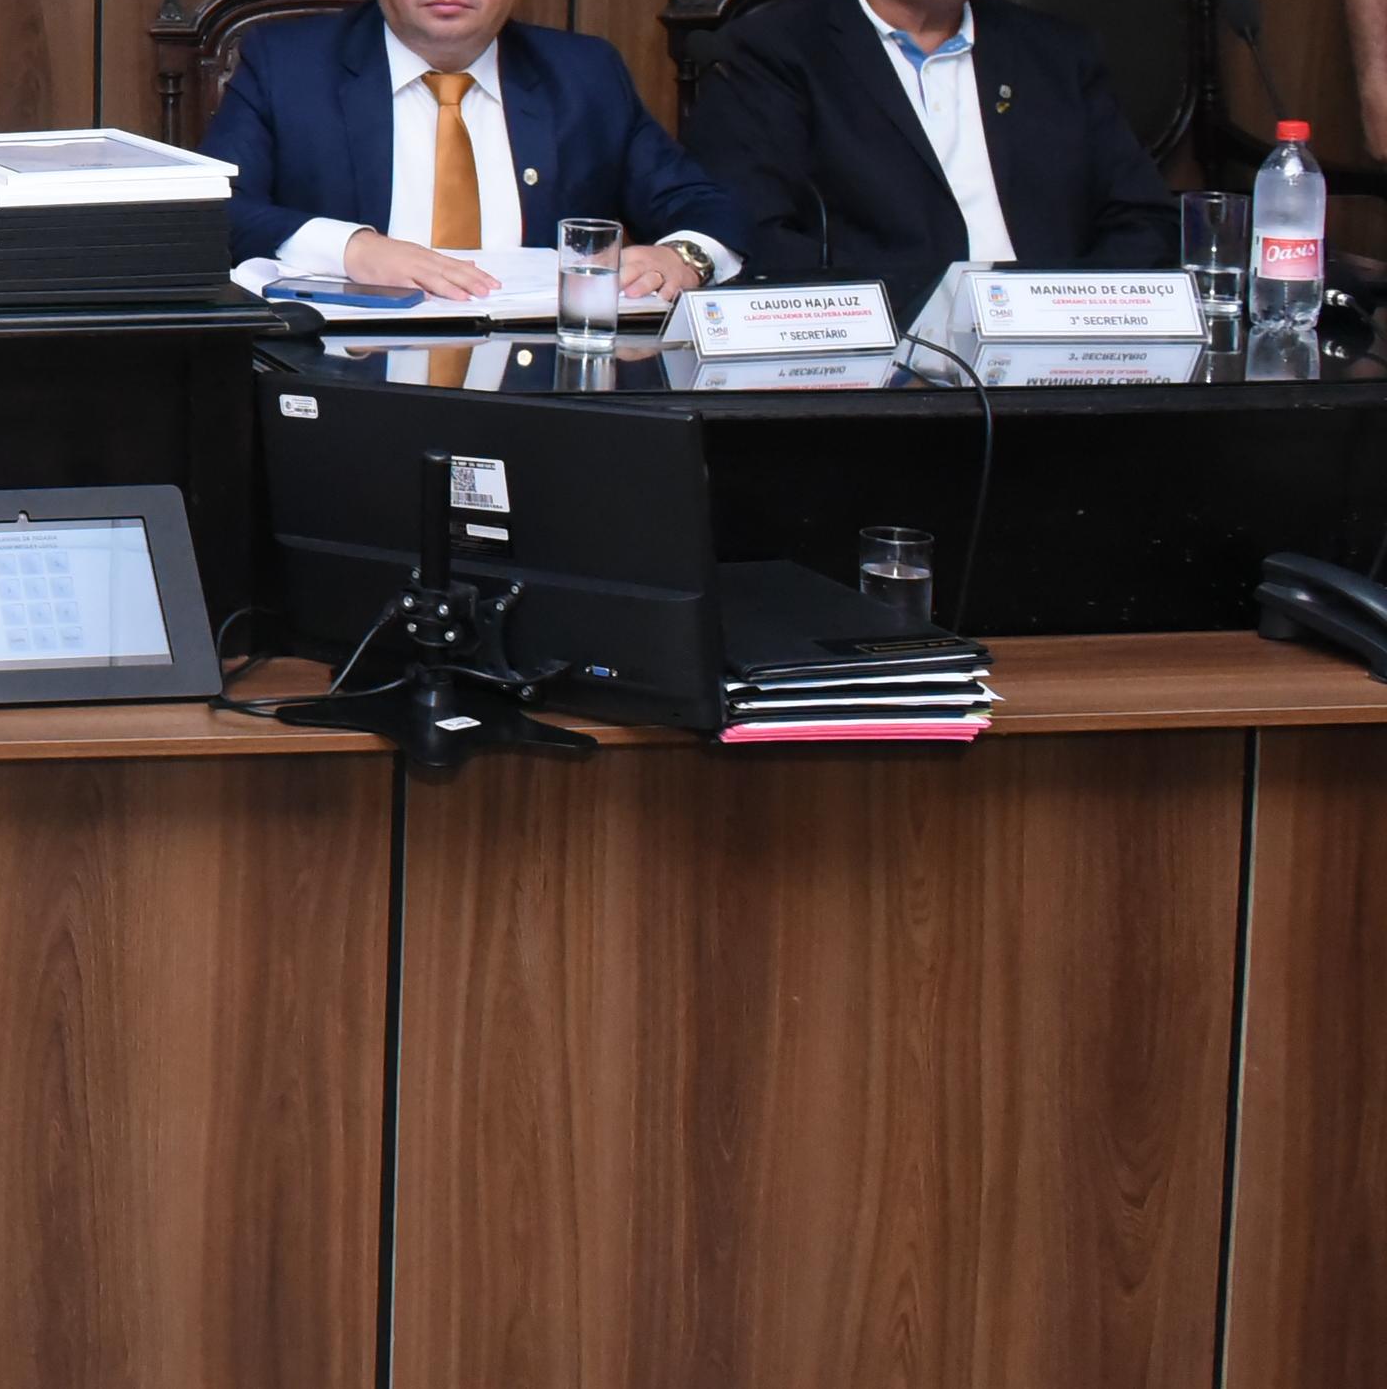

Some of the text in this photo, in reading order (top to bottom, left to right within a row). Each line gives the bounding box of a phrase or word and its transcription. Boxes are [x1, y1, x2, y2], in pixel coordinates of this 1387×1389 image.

[1030, 285, 1174, 298] MANINHO DE CABUÇU
[750, 296, 862, 311] CLAUDIO HAJA LUZ
[1083, 314, 1149, 326] SECRETÁRIO
[789, 327, 847, 341] SECRETÁRIO
